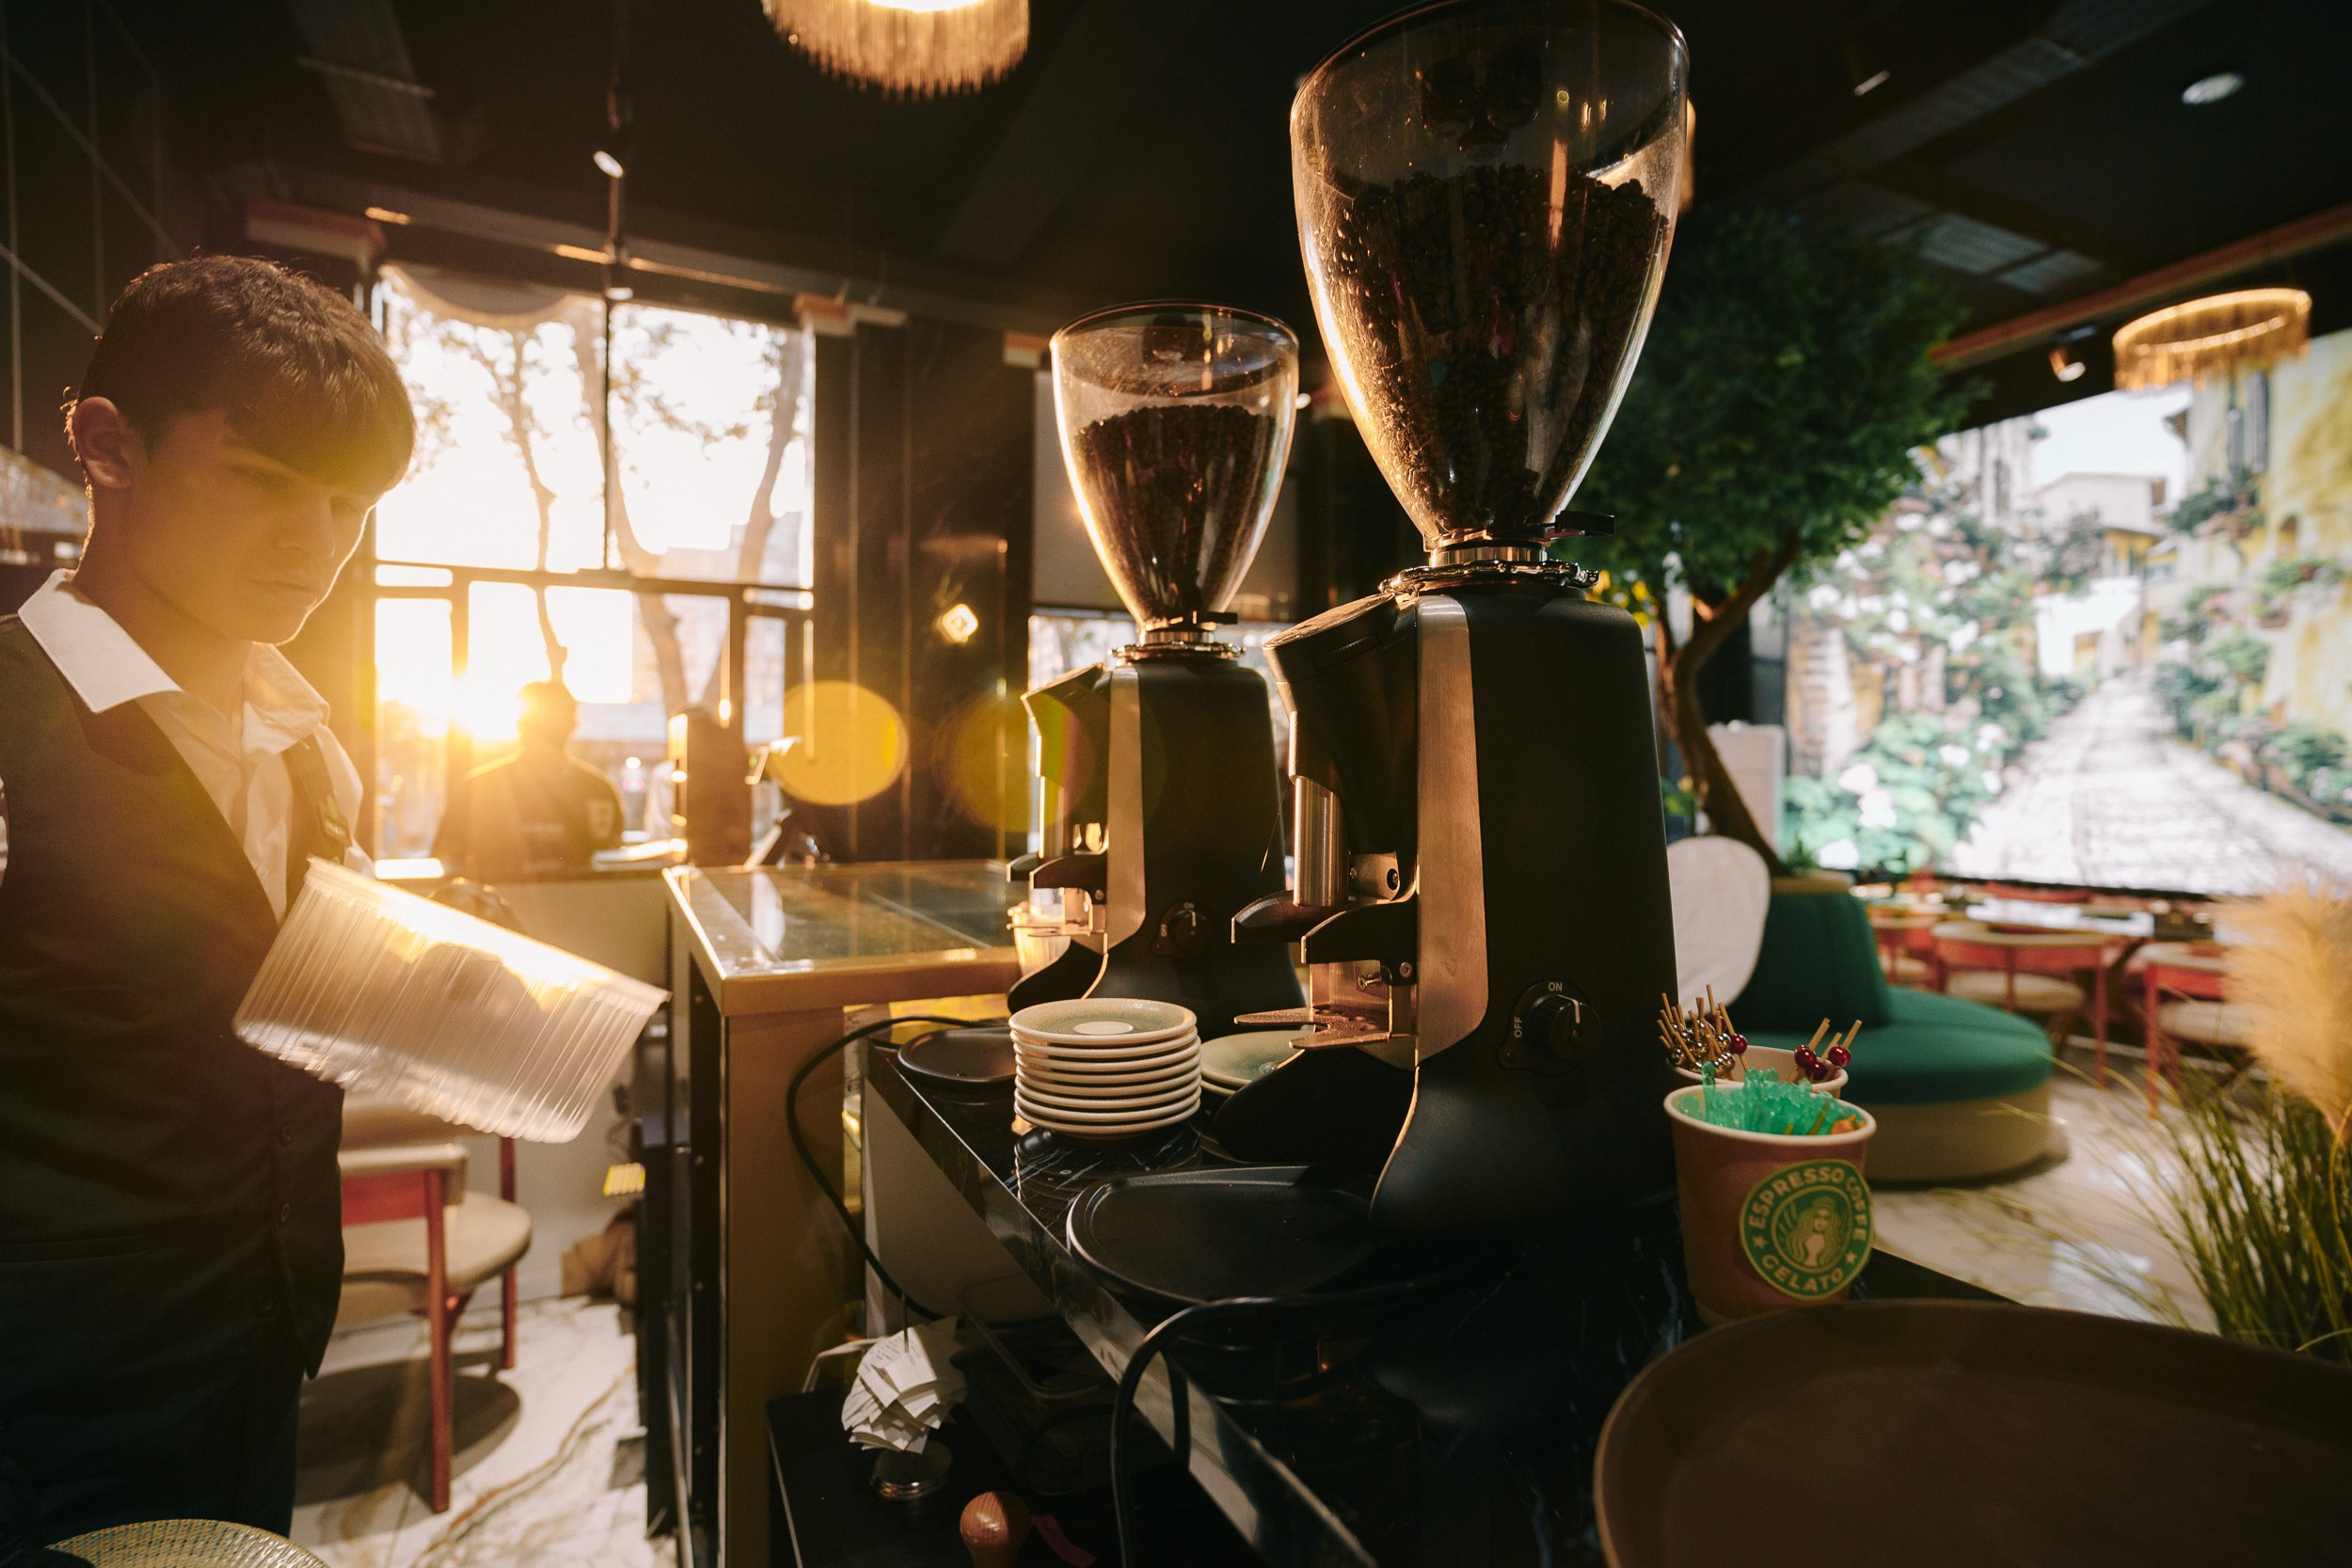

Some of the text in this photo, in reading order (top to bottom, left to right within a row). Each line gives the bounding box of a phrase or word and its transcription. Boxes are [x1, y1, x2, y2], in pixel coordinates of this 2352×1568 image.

[1548, 982, 1563, 991] ON
[1514, 1017, 1522, 1037] OFF
[1748, 1166, 1845, 1229] ESPRESSO
